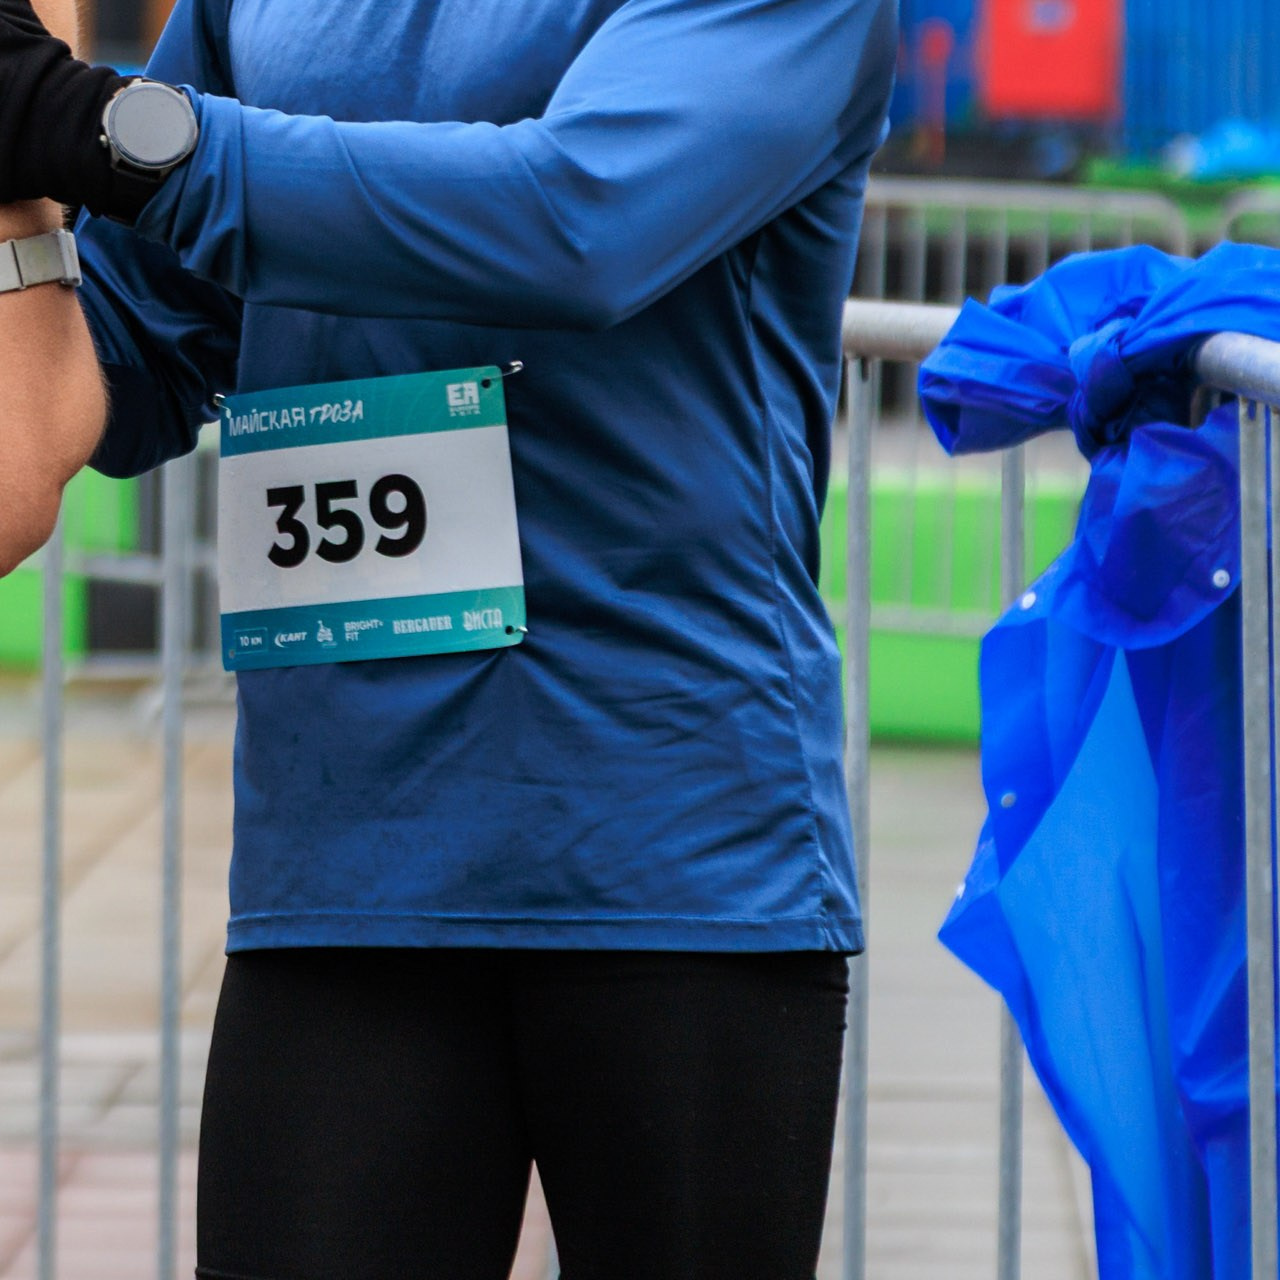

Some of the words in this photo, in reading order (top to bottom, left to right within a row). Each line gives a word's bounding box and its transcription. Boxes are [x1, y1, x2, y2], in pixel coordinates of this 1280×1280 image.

[229, 408, 306, 437] МАЙСКАЯ
[309, 399, 363, 424] ГРОЗА
[266, 473, 427, 569] 359
[240, 636, 250, 647] 10
[345, 631, 360, 642] FIT
